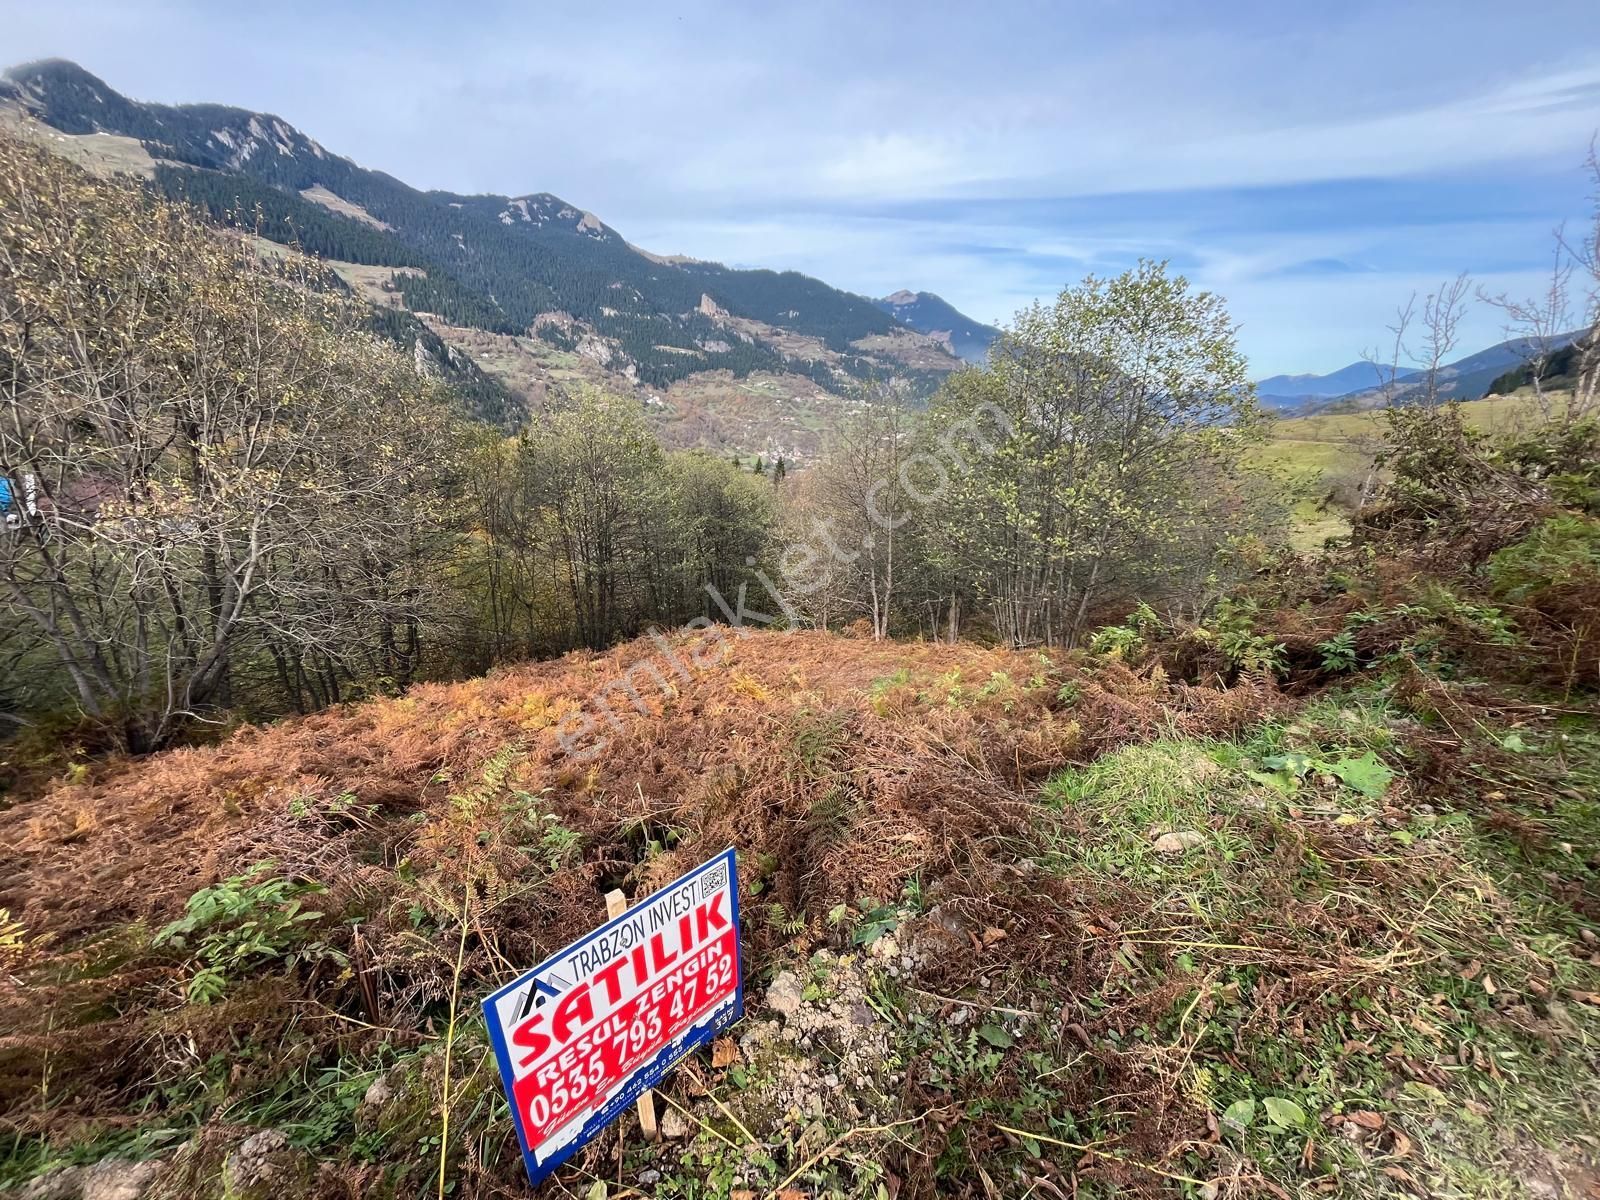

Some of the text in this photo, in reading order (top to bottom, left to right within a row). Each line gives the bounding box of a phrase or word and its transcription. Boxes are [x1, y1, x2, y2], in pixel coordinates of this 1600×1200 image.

[512, 890, 728, 1069] SATILIK
[569, 880, 698, 984] TRABZON INVEST
[529, 1049, 606, 1129] 0535
[612, 1006, 662, 1066] 793
[668, 980, 697, 1022] 47
[705, 953, 732, 995] 52
[536, 1010, 627, 1088] RESUL
[715, 1009, 734, 1030] 337
